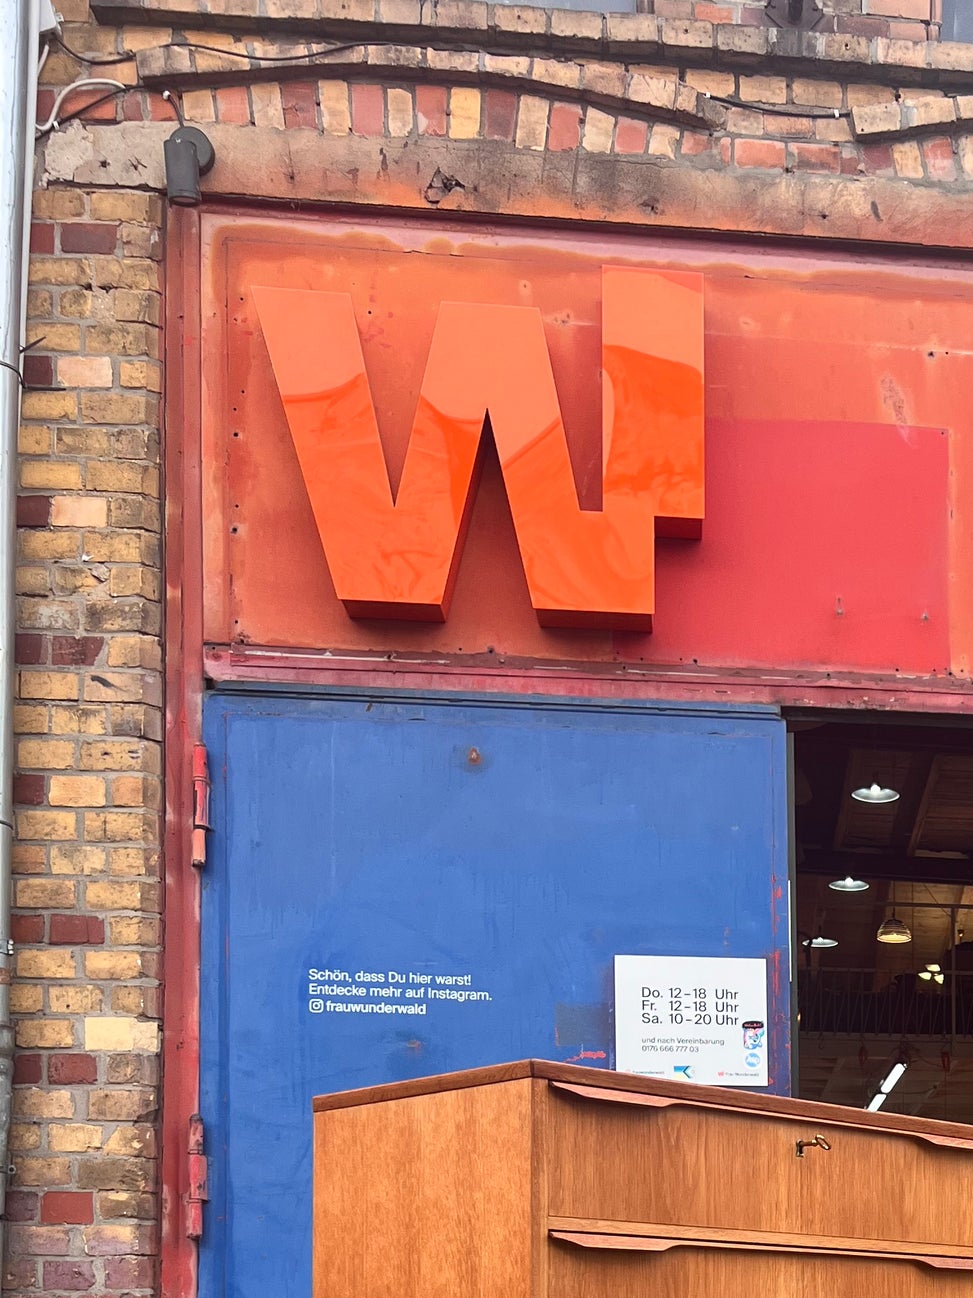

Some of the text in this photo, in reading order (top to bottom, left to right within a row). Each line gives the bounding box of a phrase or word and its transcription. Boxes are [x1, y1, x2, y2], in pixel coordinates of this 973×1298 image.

[308, 968, 472, 986] Schön, dass Du hier warst!
[308, 983, 493, 1002] Entdecke mehr auf Instagram.
[641, 987, 664, 998] Do.
[715, 988, 739, 1000] Uhr
[326, 1000, 427, 1015] frauwunderwald
[641, 1000, 657, 1011] Fr.
[715, 1001, 739, 1013] Uhr
[641, 1013, 663, 1024] Sa.
[715, 1014, 739, 1026] Uhr
[677, 1037, 725, 1046] Vereinbarung
